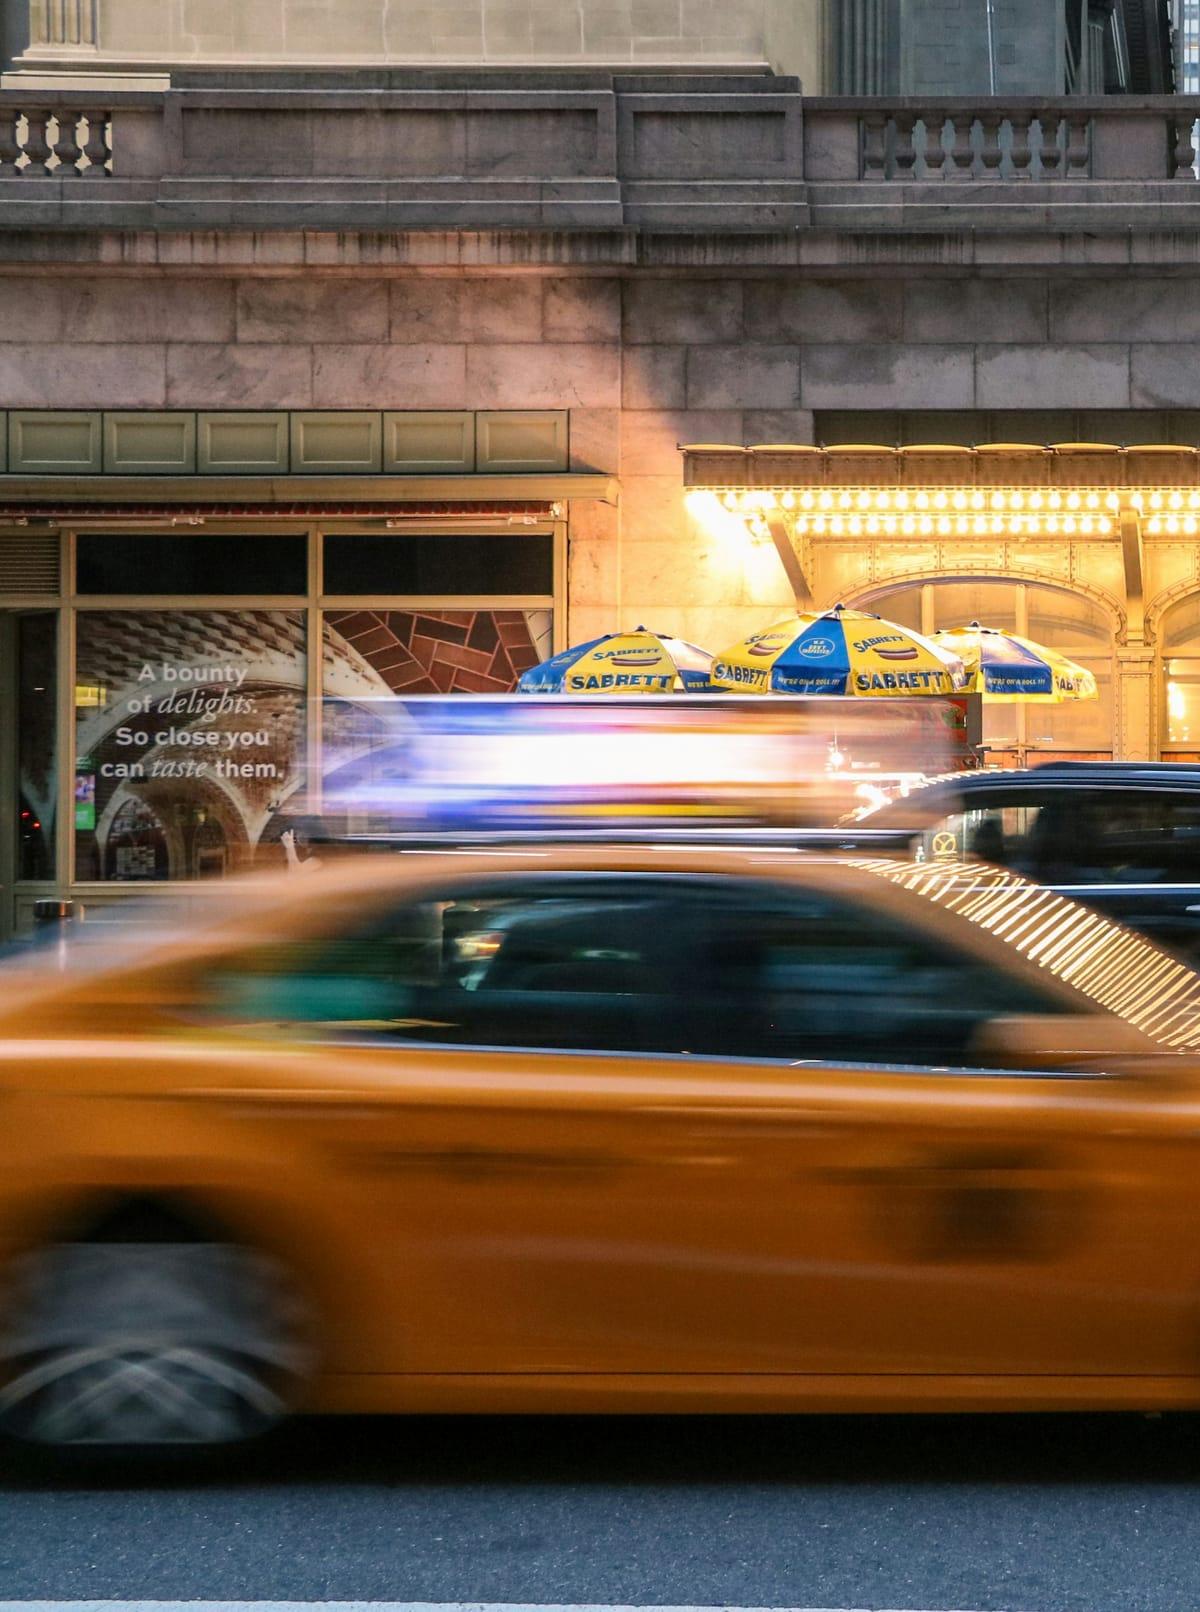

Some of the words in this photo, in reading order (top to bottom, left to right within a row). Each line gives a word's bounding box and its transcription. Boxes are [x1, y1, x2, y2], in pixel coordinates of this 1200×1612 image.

[853, 636, 904, 653] SABRETT
[138, 664, 156, 682] A
[163, 663, 249, 686] bounty
[571, 674, 672, 690] SABRETT
[715, 664, 768, 687] SABRETT
[857, 671, 943, 691] SABRETT
[127, 695, 153, 713] of
[158, 688, 258, 722] delights.
[116, 727, 148, 745] So
[155, 727, 219, 745] close
[227, 732, 270, 749] you
[101, 763, 144, 777] can
[152, 760, 209, 777] taste
[215, 759, 284, 778] them.
